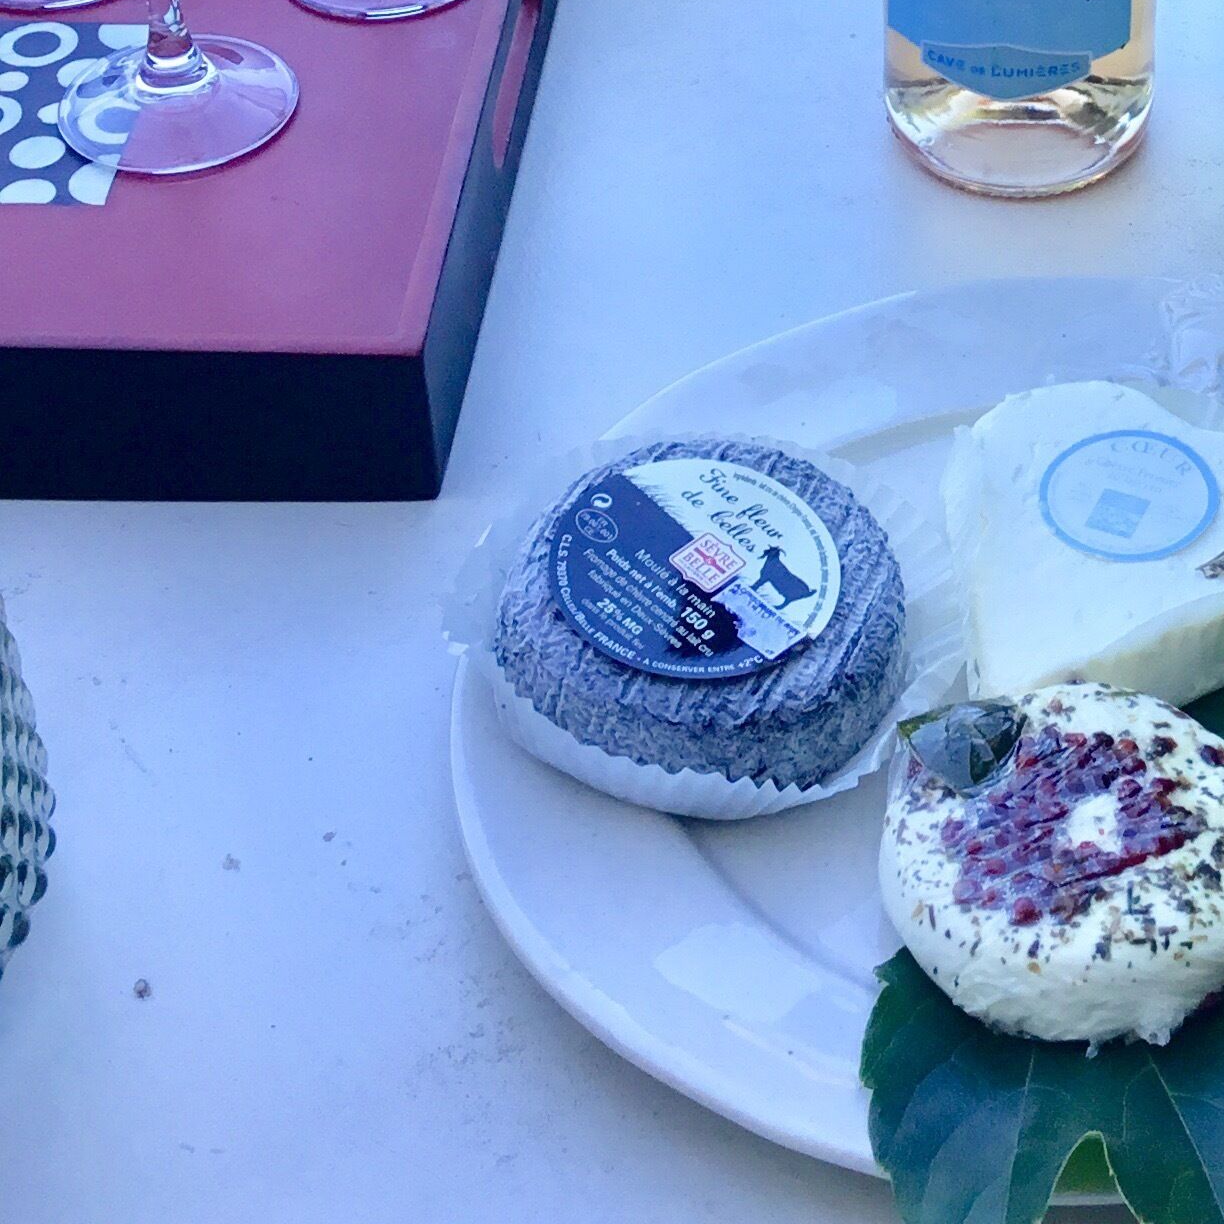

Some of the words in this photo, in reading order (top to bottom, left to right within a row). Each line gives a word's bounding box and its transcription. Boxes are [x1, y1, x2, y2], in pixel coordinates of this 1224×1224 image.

[680, 490, 704, 508] de
[698, 468, 738, 504] Fine
[734, 503, 783, 549] fleur
[682, 551, 720, 583] BELLE
[699, 533, 737, 570] SÈVRE
[605, 548, 631, 571] Poids
[628, 569, 646, 583] net
[680, 606, 708, 629] 150
[700, 629, 715, 640] g
[675, 583, 689, 595] la
[686, 593, 715, 618] main
[621, 617, 643, 635] MG
[593, 631, 637, 659] FRANCE
[652, 662, 705, 673] CONSERVER
